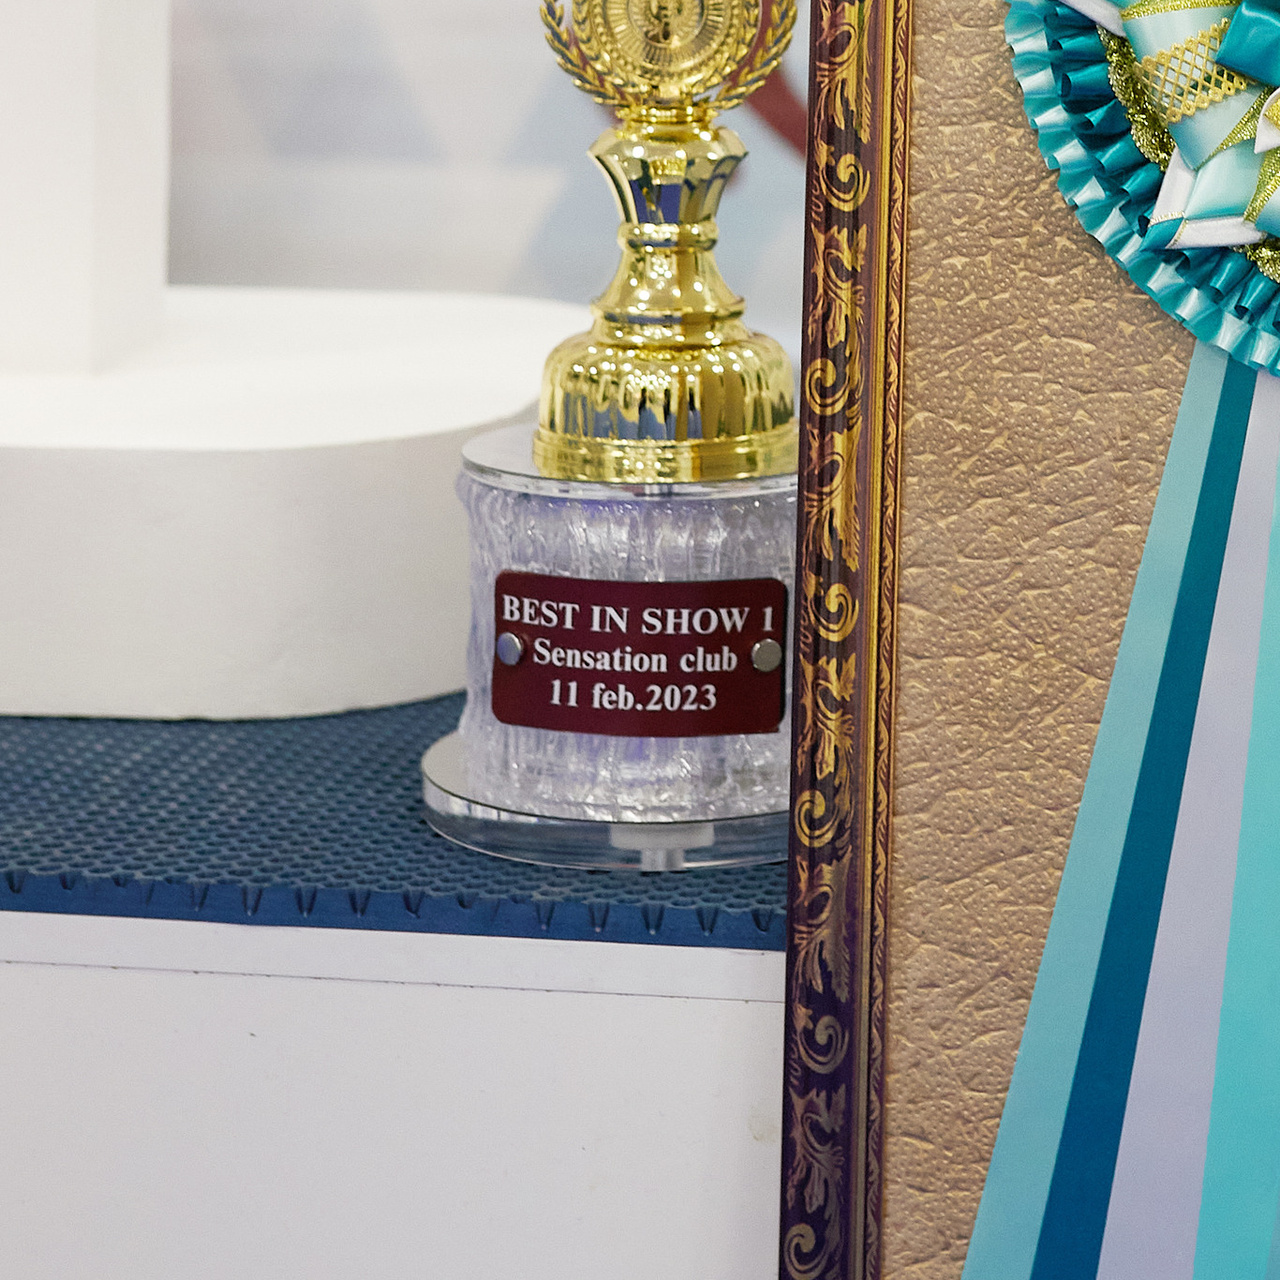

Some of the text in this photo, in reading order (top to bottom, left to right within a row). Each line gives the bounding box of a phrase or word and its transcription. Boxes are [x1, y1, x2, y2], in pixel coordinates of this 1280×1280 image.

[502, 594, 774, 636] BEST IN SHOW 1
[533, 637, 738, 673] Sensation club
[550, 679, 718, 712] 11 feb.2023
